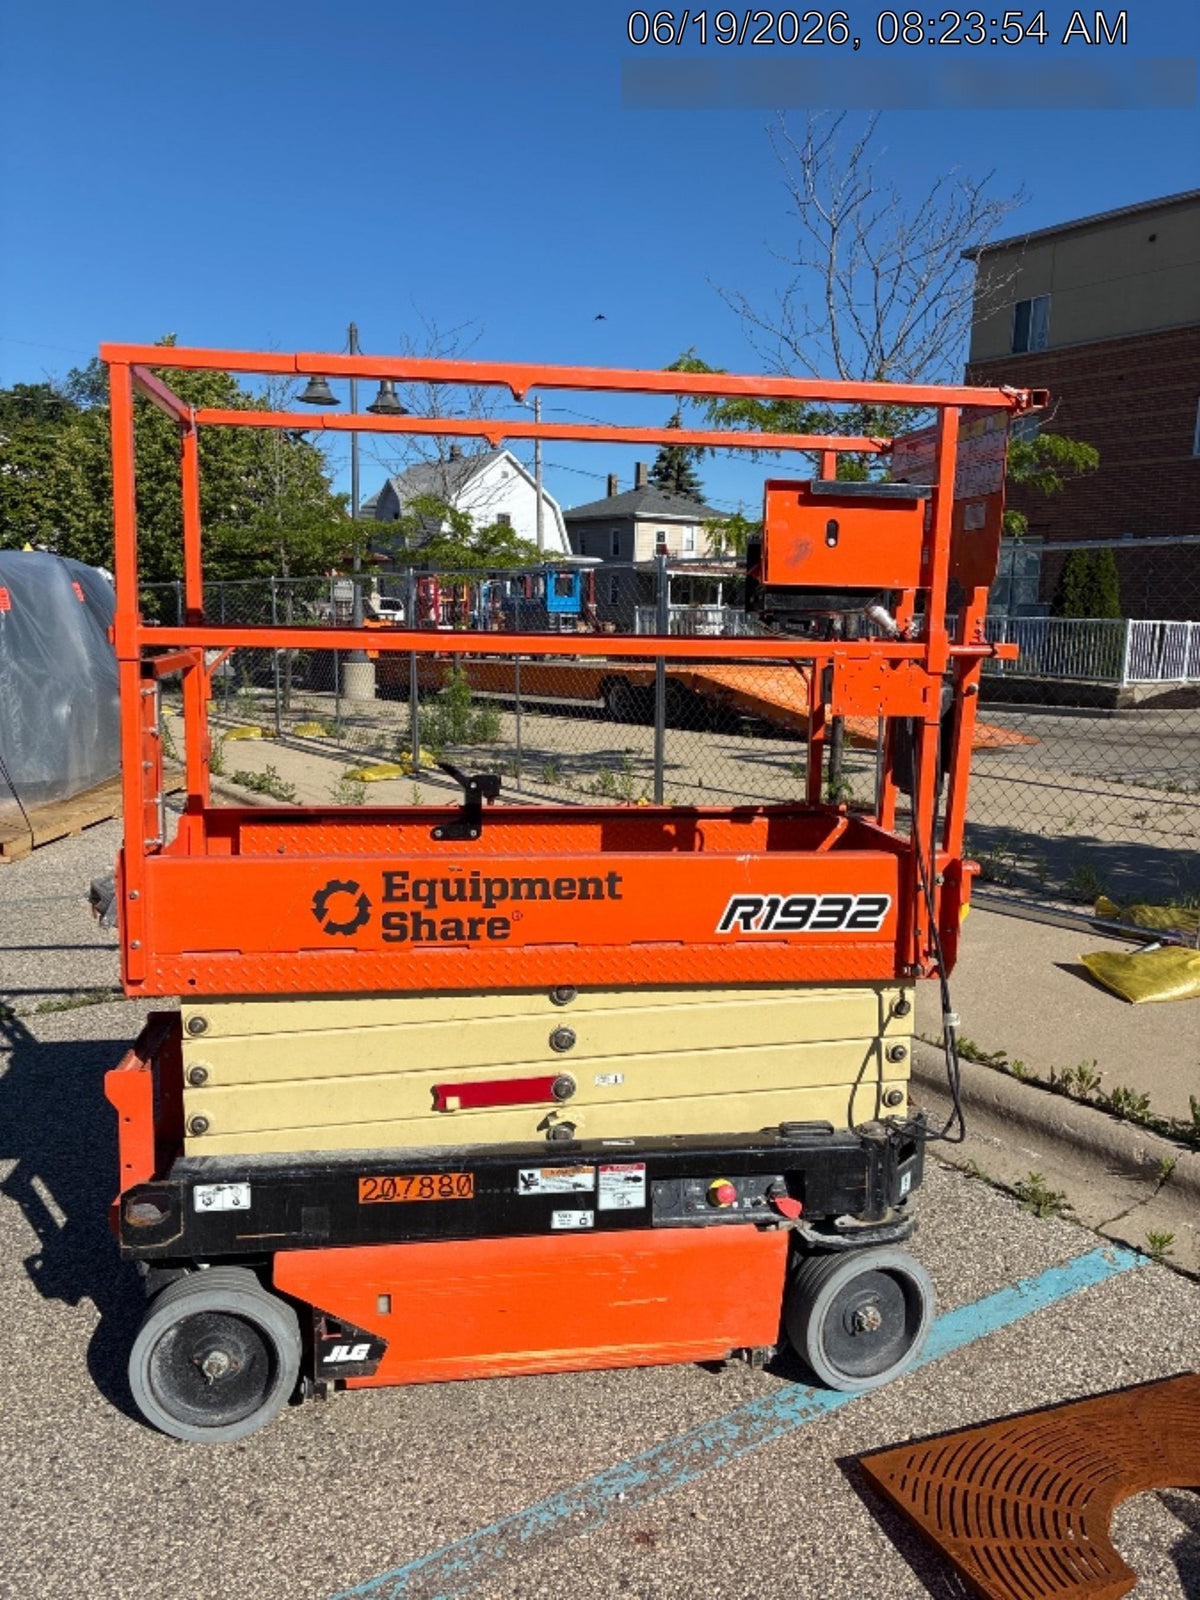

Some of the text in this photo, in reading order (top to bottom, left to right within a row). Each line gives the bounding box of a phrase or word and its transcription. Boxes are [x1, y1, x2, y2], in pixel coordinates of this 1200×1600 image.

[382, 871, 624, 909] Equipment
[382, 911, 511, 943] Share
[716, 894, 892, 933] R1932
[362, 1174, 472, 1201] 207880
[323, 1343, 371, 1363] JLG
